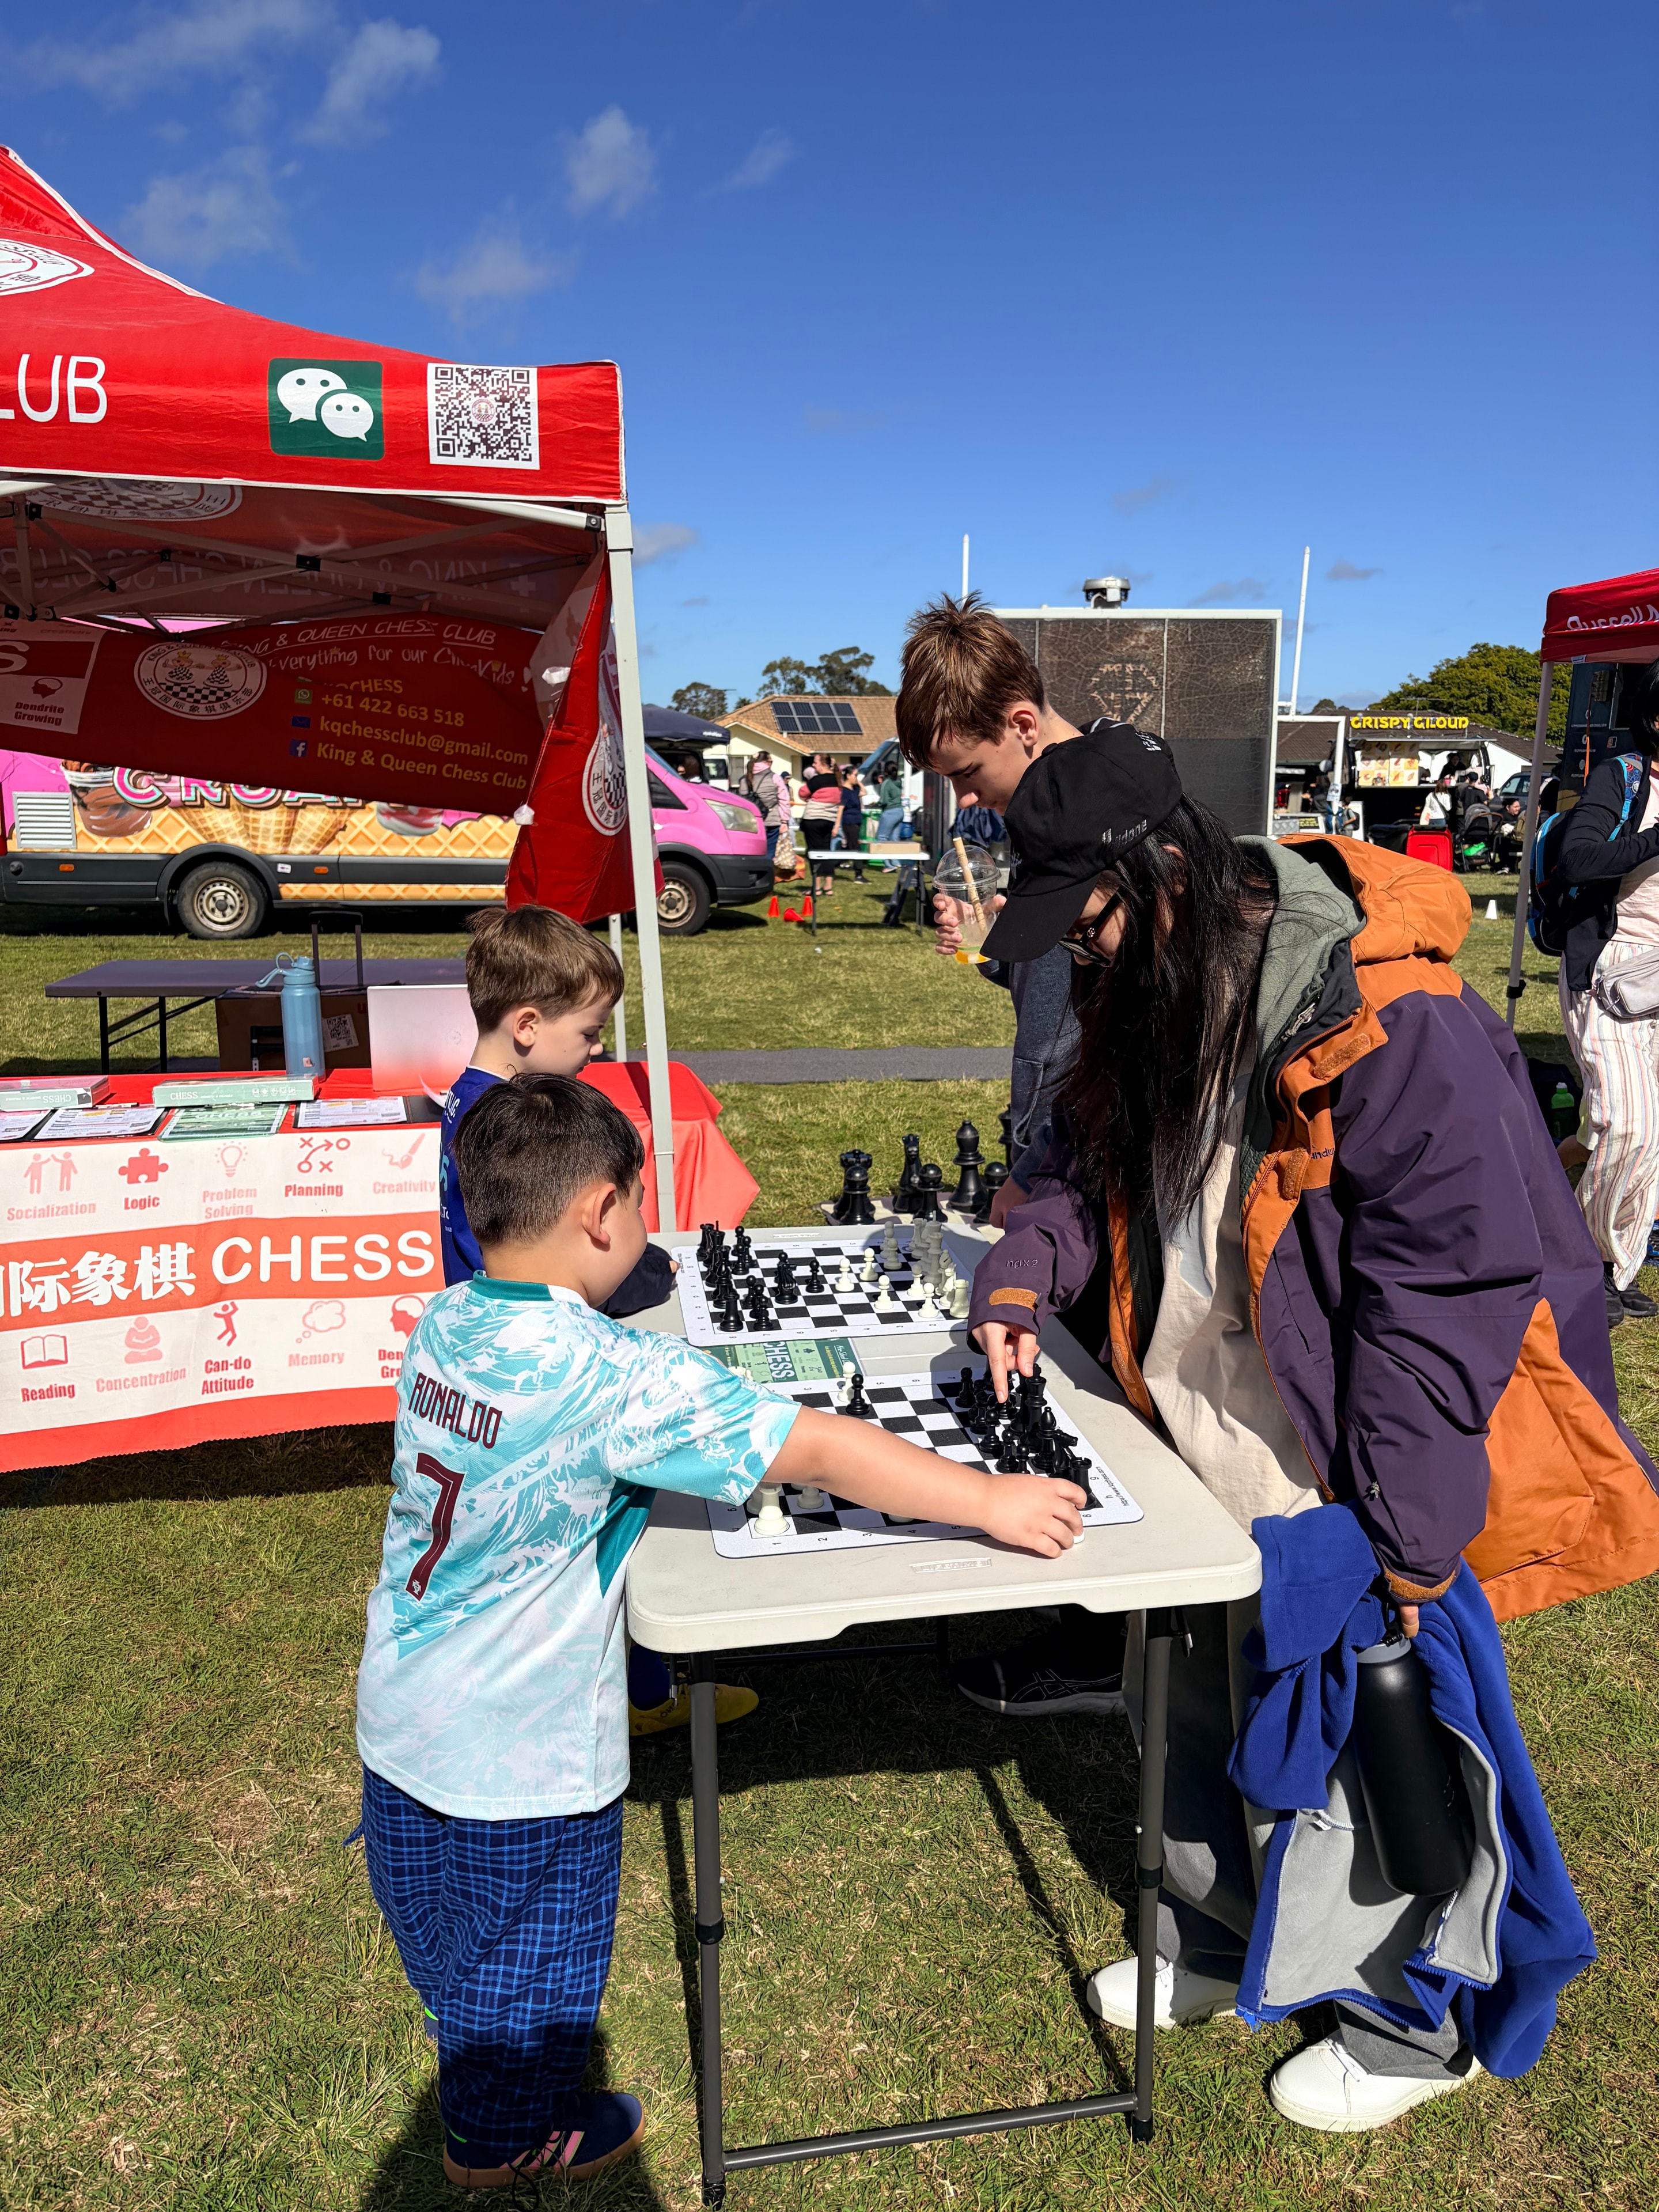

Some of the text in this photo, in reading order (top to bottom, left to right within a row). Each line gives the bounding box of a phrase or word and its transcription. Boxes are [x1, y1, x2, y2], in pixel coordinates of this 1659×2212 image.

[276, 634, 289, 647] &
[297, 624, 366, 643] QUEEN
[443, 623, 497, 645] CLUB
[368, 645, 393, 662] for
[402, 648, 427, 664] our
[15, 702, 65, 715] Dendrite
[321, 694, 464, 728] +61 422 663 518
[14, 711, 62, 726] Growing
[1350, 716, 1410, 729] CRISPY
[319, 716, 529, 766] kqchessclub@gmail.com
[317, 743, 356, 767] King
[361, 750, 376, 767] &
[381, 753, 437, 776] Queen
[442, 764, 488, 783] Chess
[493, 772, 527, 790] Club
[43, 1094, 72, 1104] CHESS
[170, 1091, 199, 1100] CHESS
[202, 1187, 257, 1203] Problem
[285, 1183, 343, 1197] Planning
[373, 1180, 436, 1195] Creativity
[6, 1202, 97, 1221] Socialization
[124, 1196, 160, 1210] Logic
[204, 1204, 253, 1220] Solving
[211, 1230, 435, 1285] CHESS
[0, 1242, 197, 1317] 际象棋
[204, 1356, 252, 1374] Can-do
[288, 1353, 345, 1368] Memory
[763, 1341, 795, 1378] CHESS
[96, 1368, 186, 1393] Concentration
[202, 1376, 254, 1395] Attitude
[21, 1384, 75, 1403] Reading
[408, 1372, 503, 1449] RONALDO
[406, 1452, 465, 1601] 7
